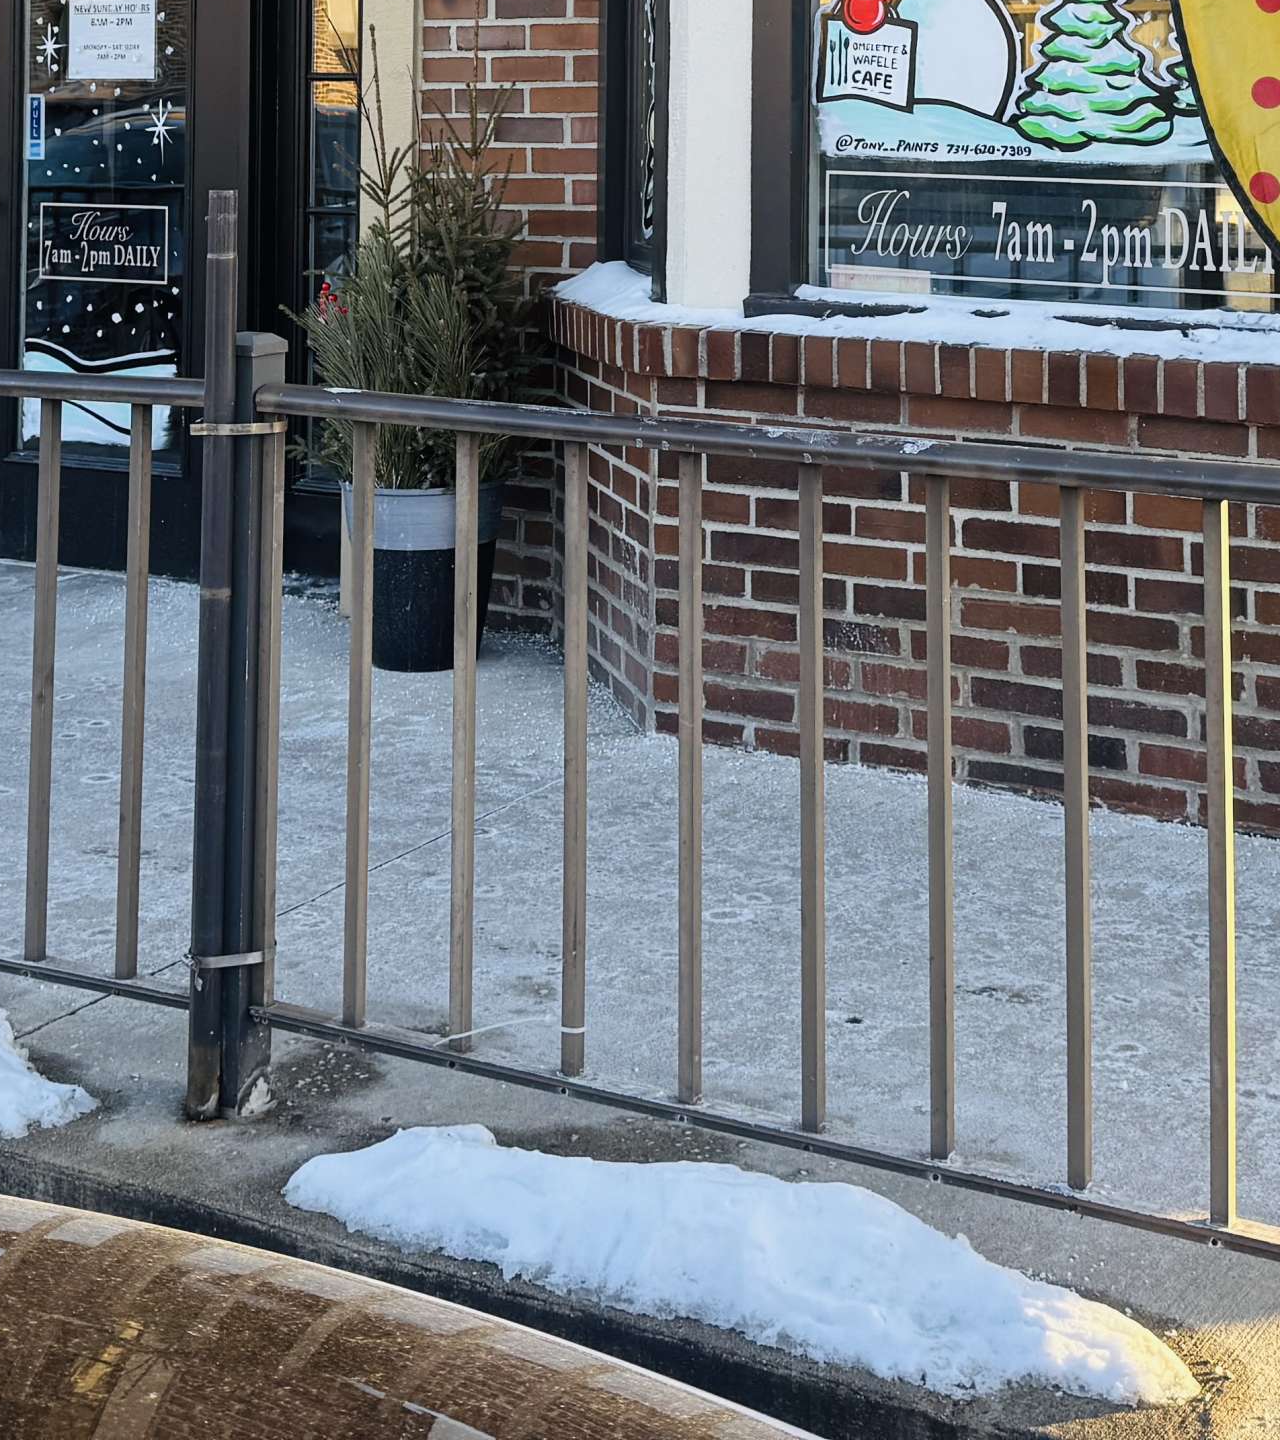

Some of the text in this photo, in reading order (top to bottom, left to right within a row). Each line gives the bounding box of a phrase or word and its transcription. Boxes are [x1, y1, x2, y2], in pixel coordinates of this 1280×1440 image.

[852, 70, 893, 89] CAFE
[32, 100, 40, 137] PULL
[70, 211, 133, 242] Hours
[851, 189, 974, 259] Hours
[114, 244, 161, 268] DAILY
